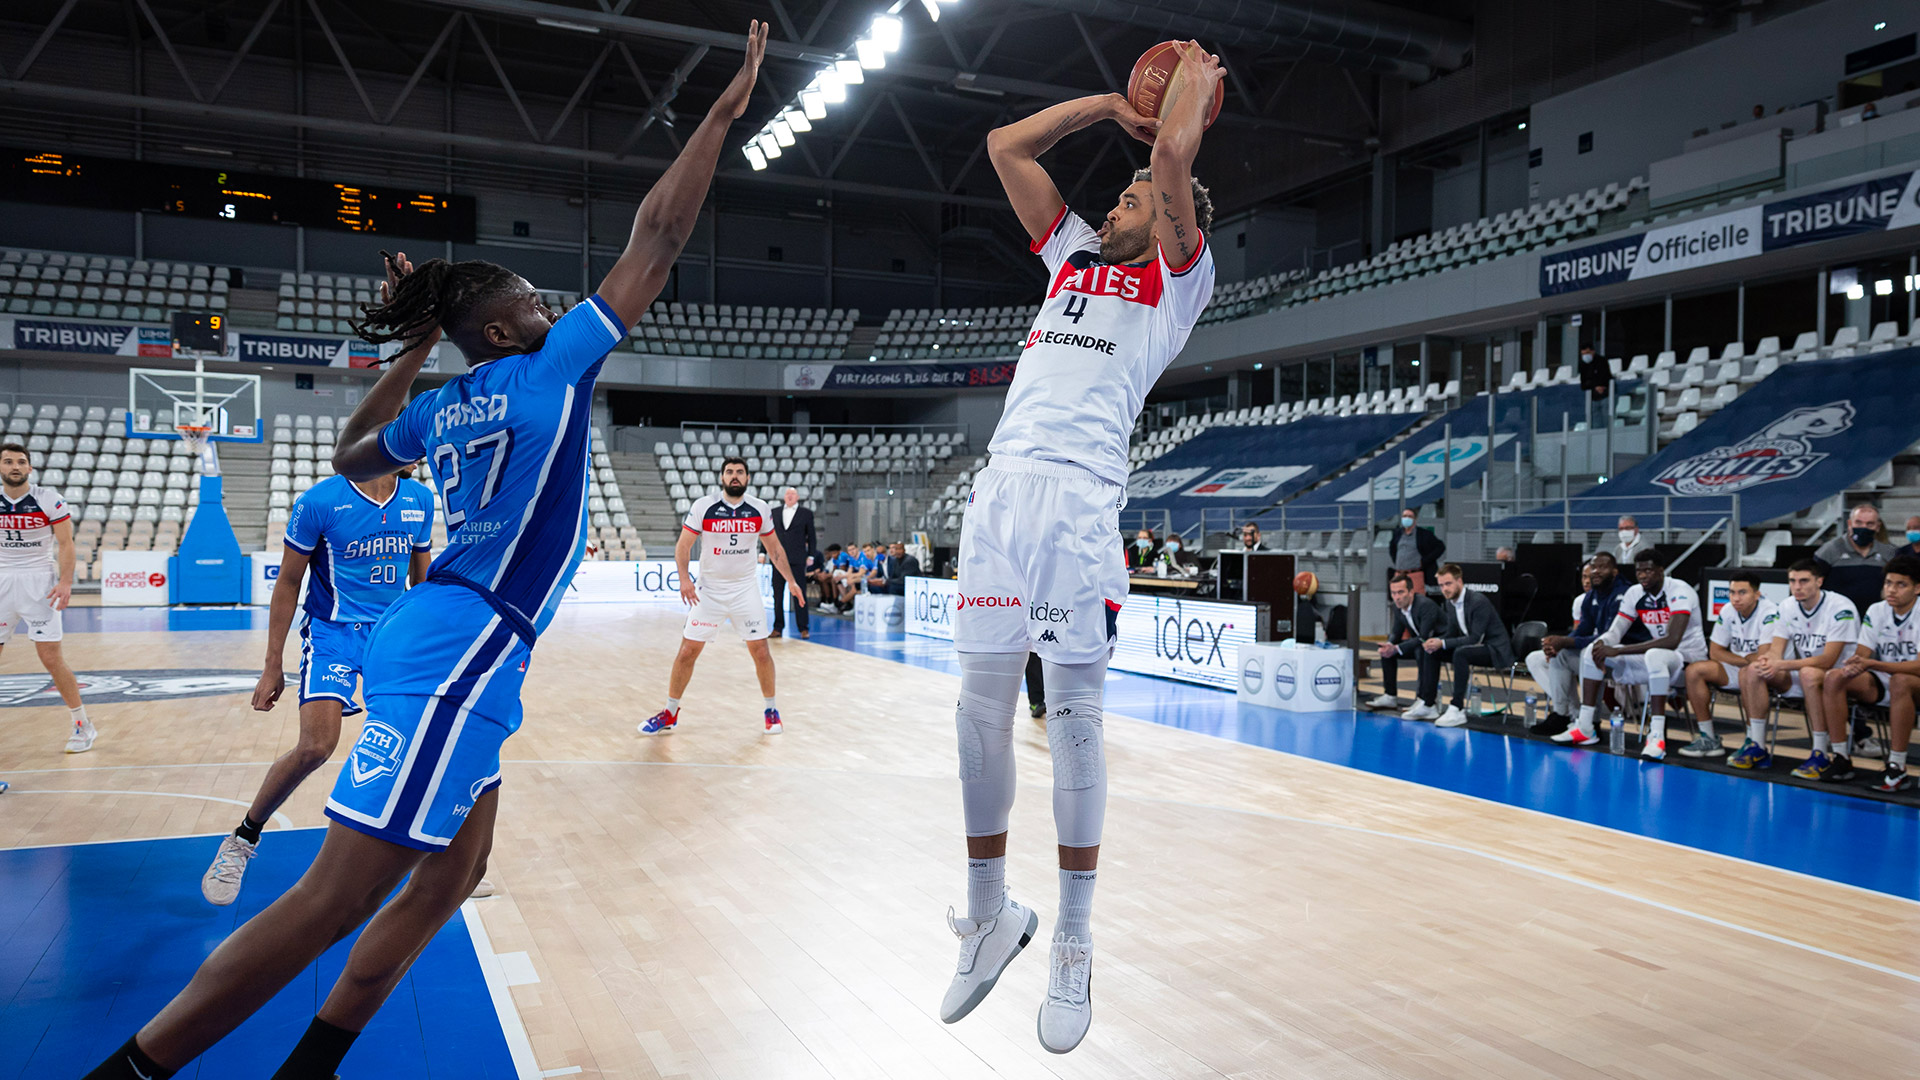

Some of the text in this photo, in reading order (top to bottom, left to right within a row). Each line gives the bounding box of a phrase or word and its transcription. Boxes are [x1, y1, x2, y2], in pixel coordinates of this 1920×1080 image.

[1769, 188, 1899, 238] TRIBUNE
[1545, 223, 1750, 285] TRIBUNE Officielle
[1062, 295, 1088, 324] 4
[210, 316, 221, 330] 9
[19, 327, 125, 348] TRIBUNE
[1039, 331, 1117, 356] LEGENDRE
[243, 340, 337, 360] TRIBUNE
[835, 373, 901, 385] PARTAGEONS
[904, 373, 930, 383] PLUS
[931, 373, 949, 383] QUE
[952, 372, 965, 382] DU
[433, 427, 514, 527] 27
[1665, 454, 1814, 479] NANTES
[5, 530, 24, 541] 11
[711, 520, 757, 532] NANTES
[730, 534, 738, 546] 5
[105, 579, 146, 588] france
[370, 564, 396, 584] 20
[914, 579, 954, 625] idex
[967, 596, 1022, 608] VEOLIA
[1030, 602, 1073, 624] idex
[1154, 597, 1234, 668] idex
